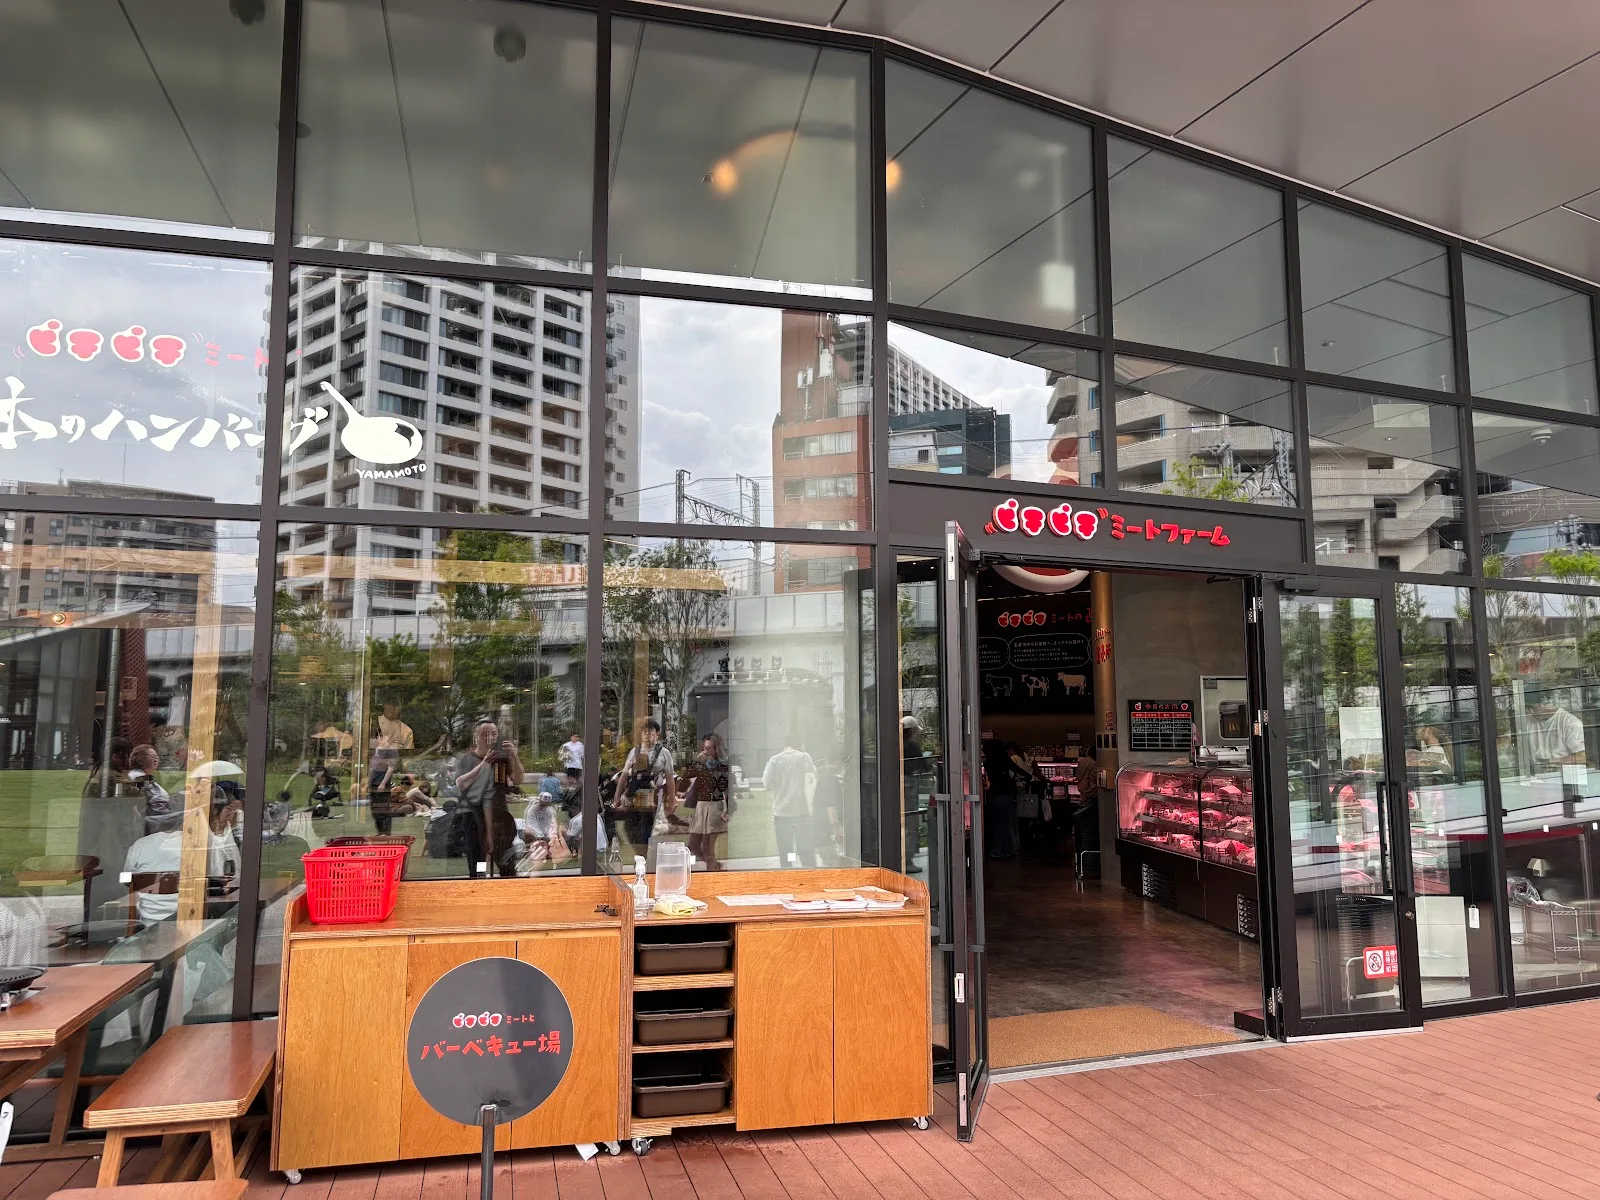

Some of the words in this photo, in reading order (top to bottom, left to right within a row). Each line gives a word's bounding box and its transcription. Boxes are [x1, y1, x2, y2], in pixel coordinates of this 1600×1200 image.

[205, 342, 269, 369] ミート
[355, 463, 427, 480] YAMAMOTO
[1110, 514, 1231, 547] ミートファーム
[506, 1013, 535, 1024] ミートと
[420, 1030, 561, 1060] バーベキュー場
